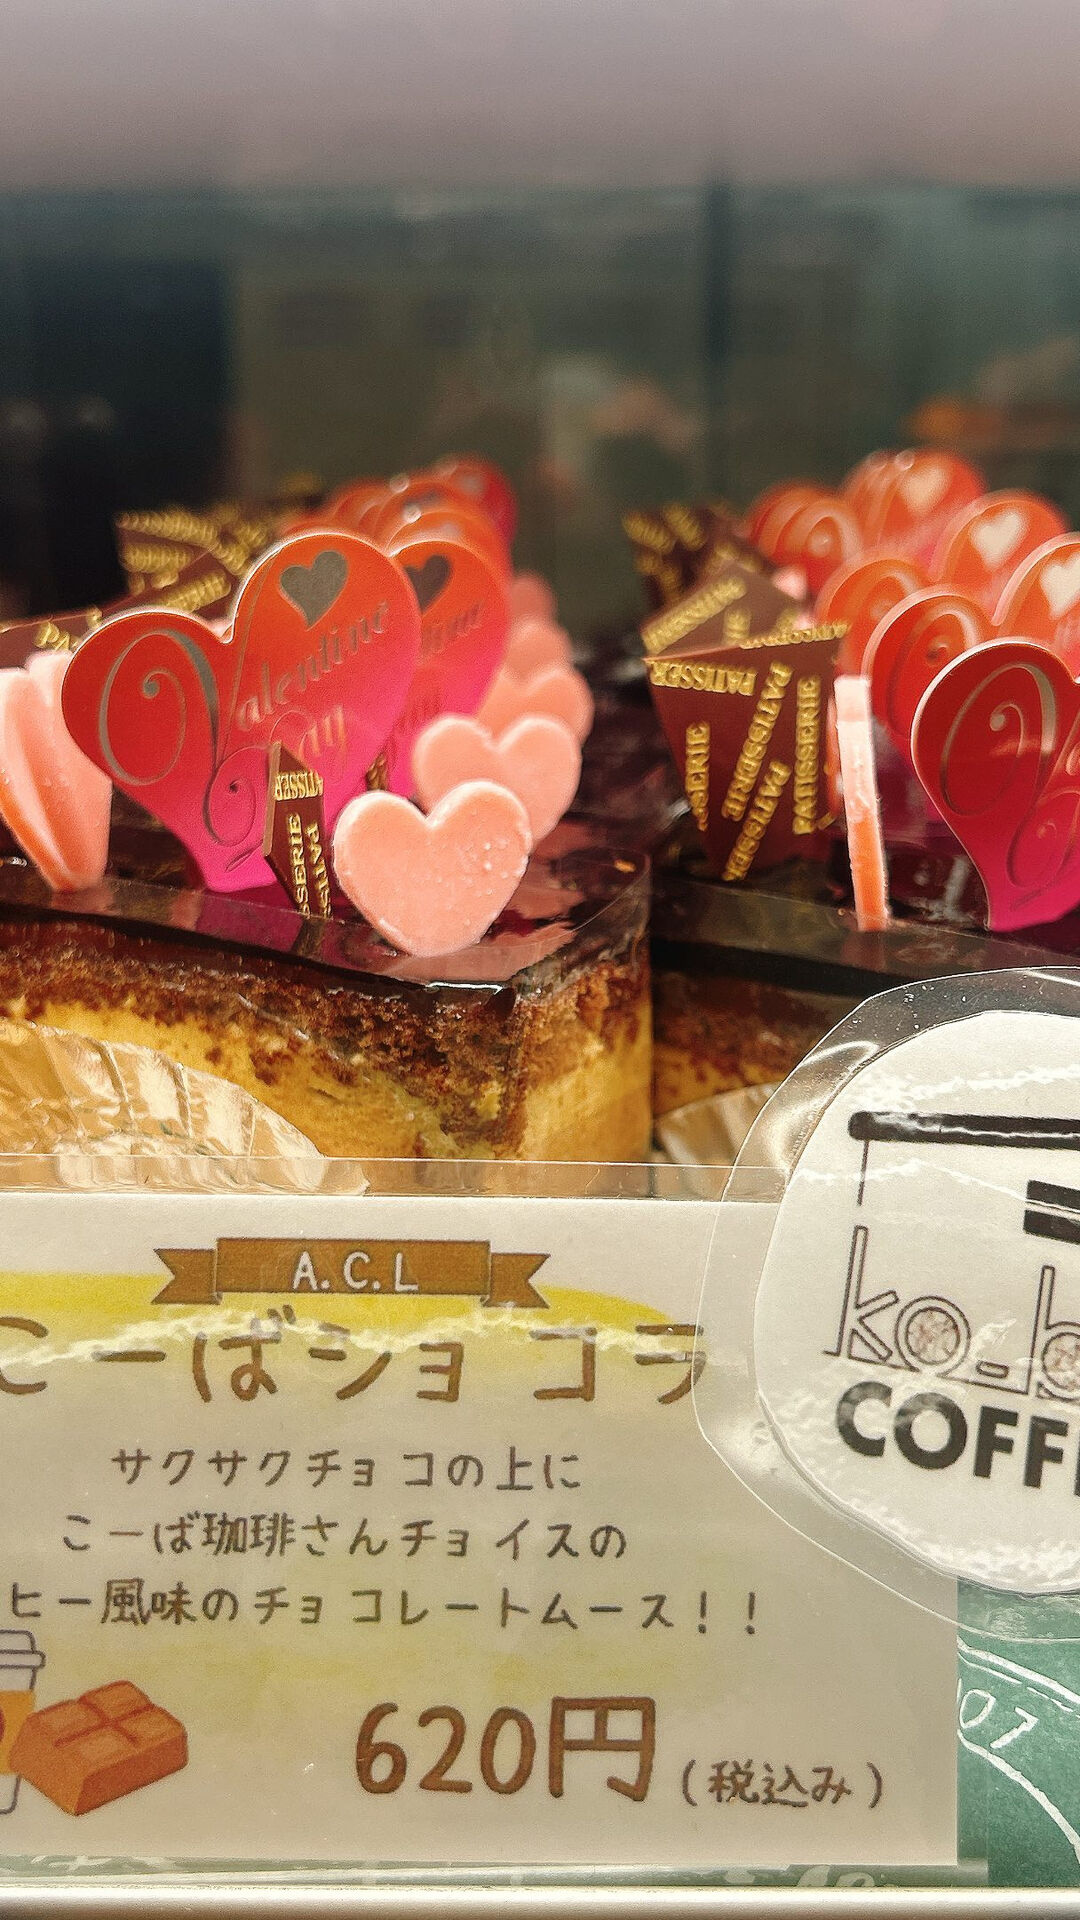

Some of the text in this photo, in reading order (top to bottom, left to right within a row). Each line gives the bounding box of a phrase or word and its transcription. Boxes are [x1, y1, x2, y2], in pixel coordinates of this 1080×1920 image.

[723, 661, 792, 821] PATISSERIE
[793, 677, 821, 834] PATISSERIE
[292, 1251, 418, 1291] A.C.L
[111, 1446, 582, 1492] サクサクチョコの上に
[837, 1380, 1080, 1497] COFF
[62, 1511, 627, 1559] こーば珈琲さんチョイスの
[356, 1697, 655, 1802] 620円
